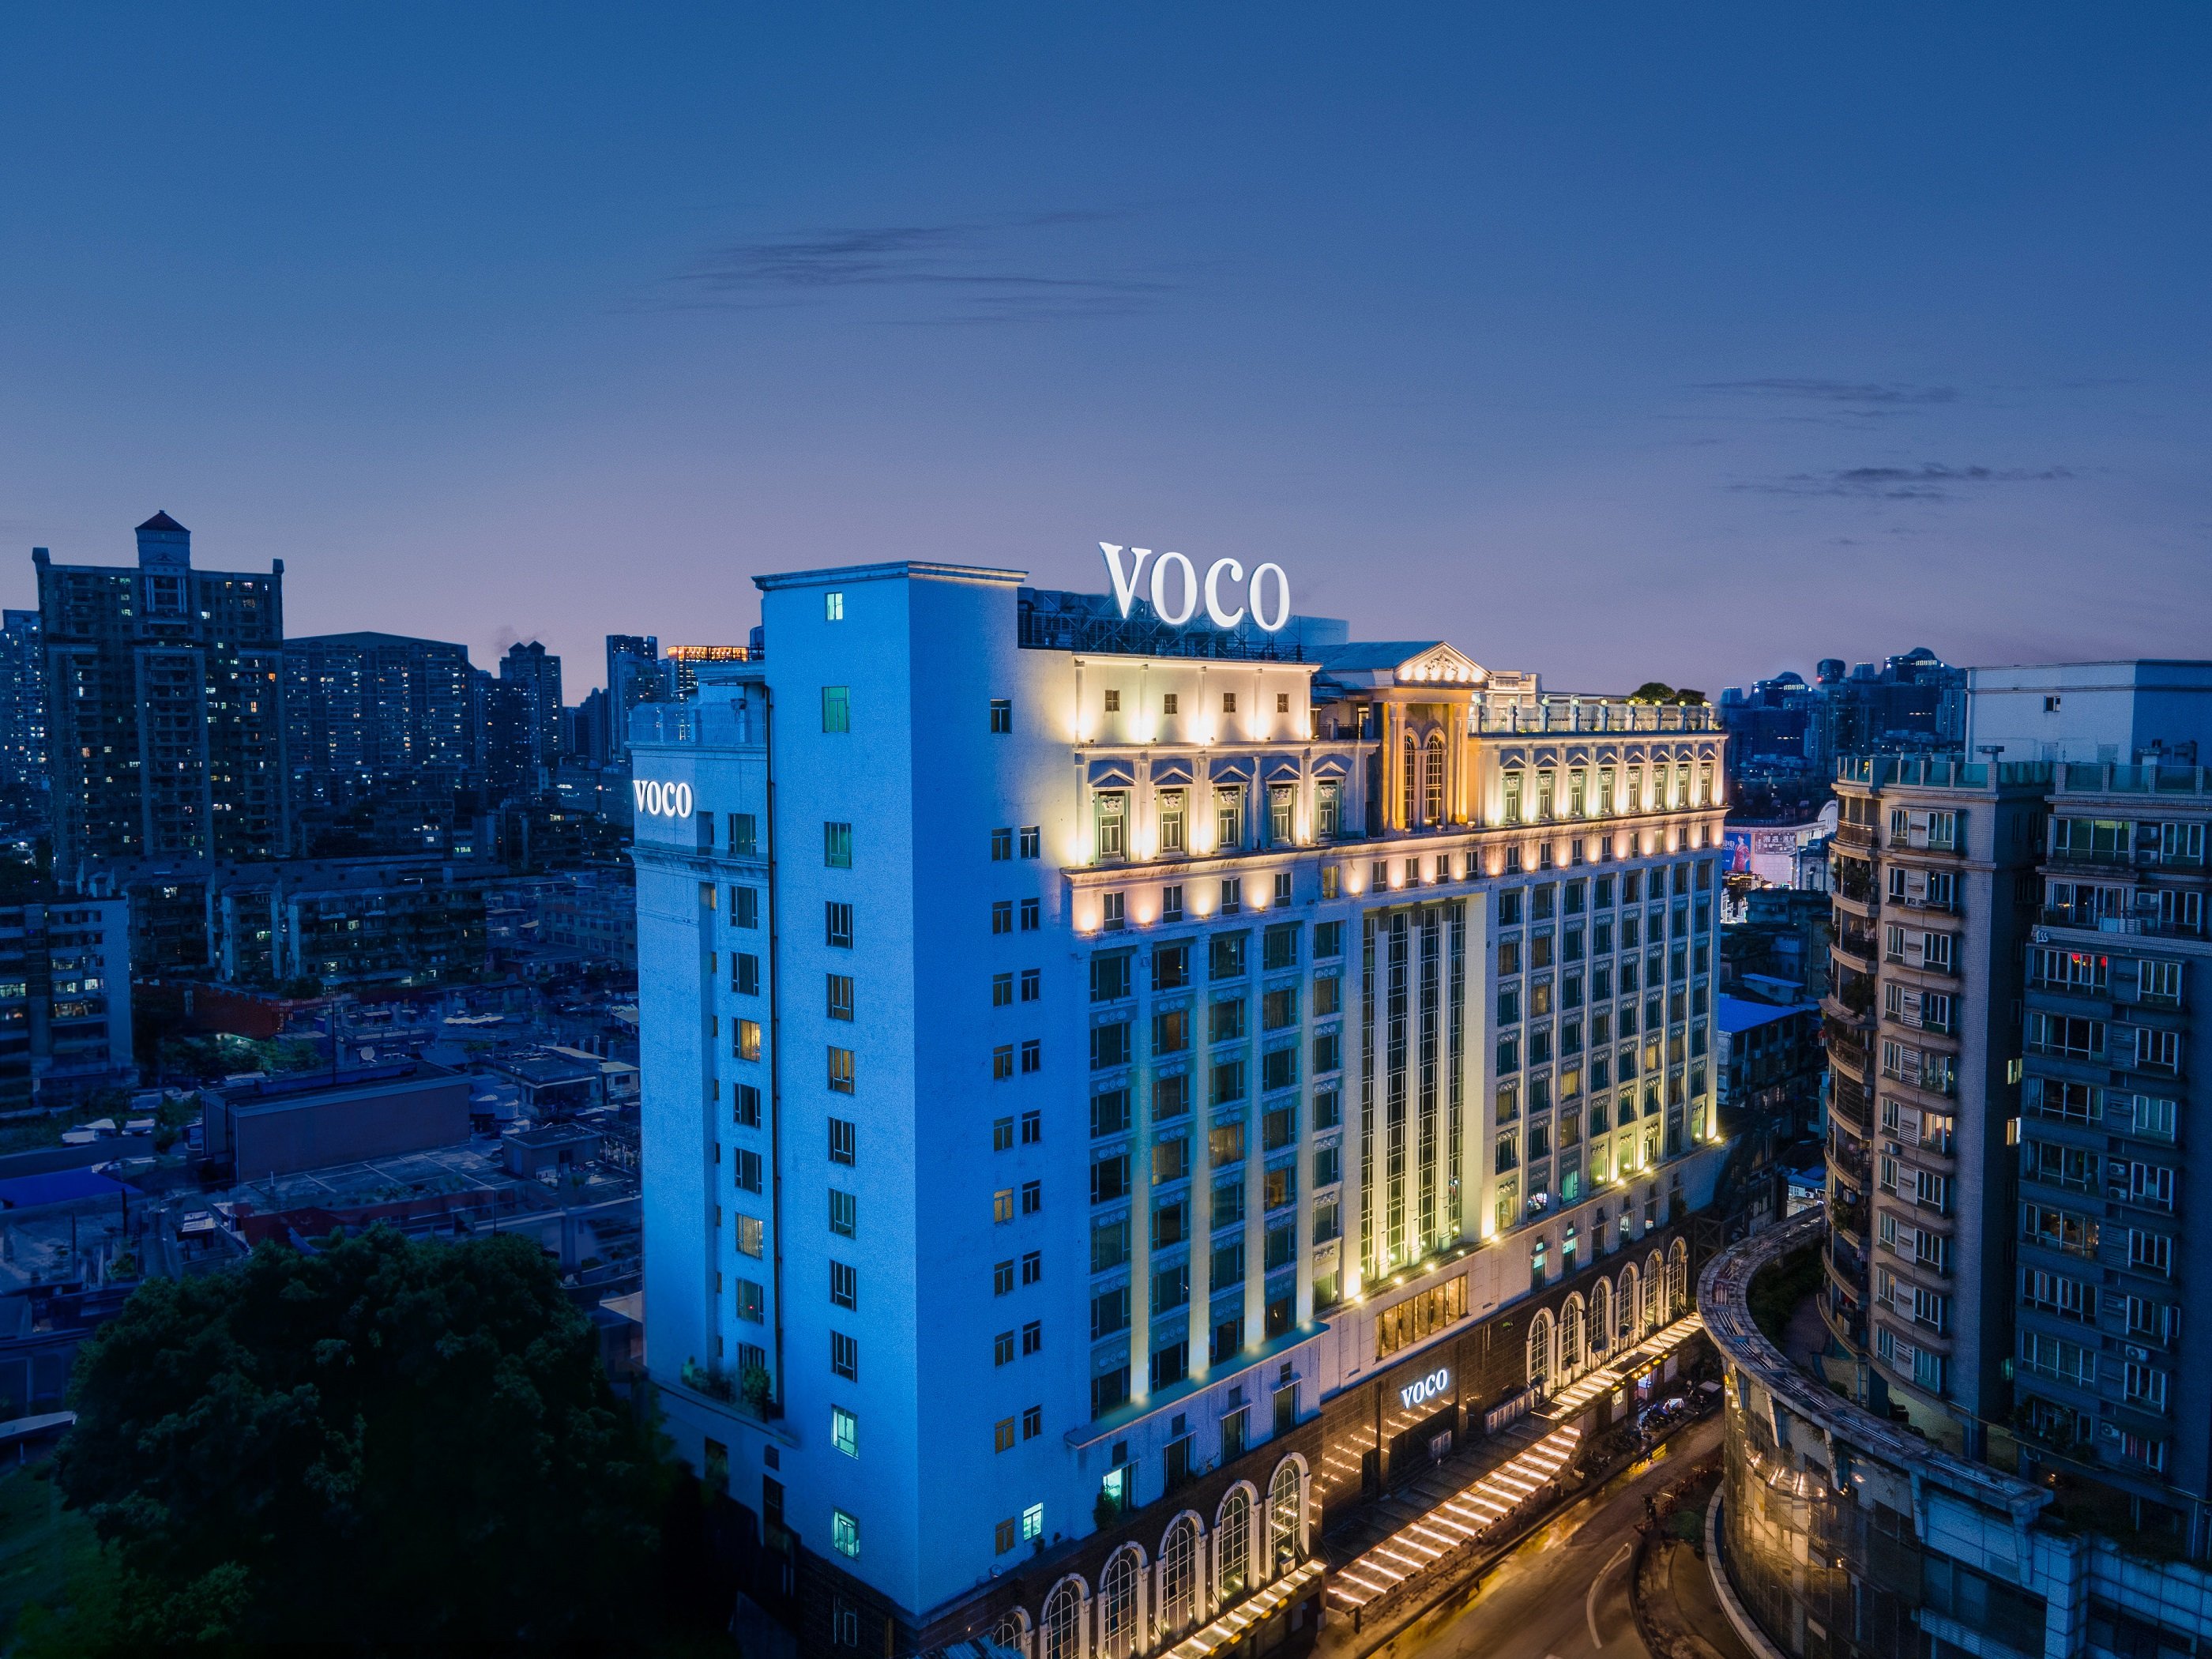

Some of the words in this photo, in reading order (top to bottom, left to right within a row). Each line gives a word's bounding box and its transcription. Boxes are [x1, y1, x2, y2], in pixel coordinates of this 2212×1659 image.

[1099, 542, 1289, 631] VOCO
[633, 780, 693, 818] VOCO
[1401, 1369, 1448, 1409] VOCO
